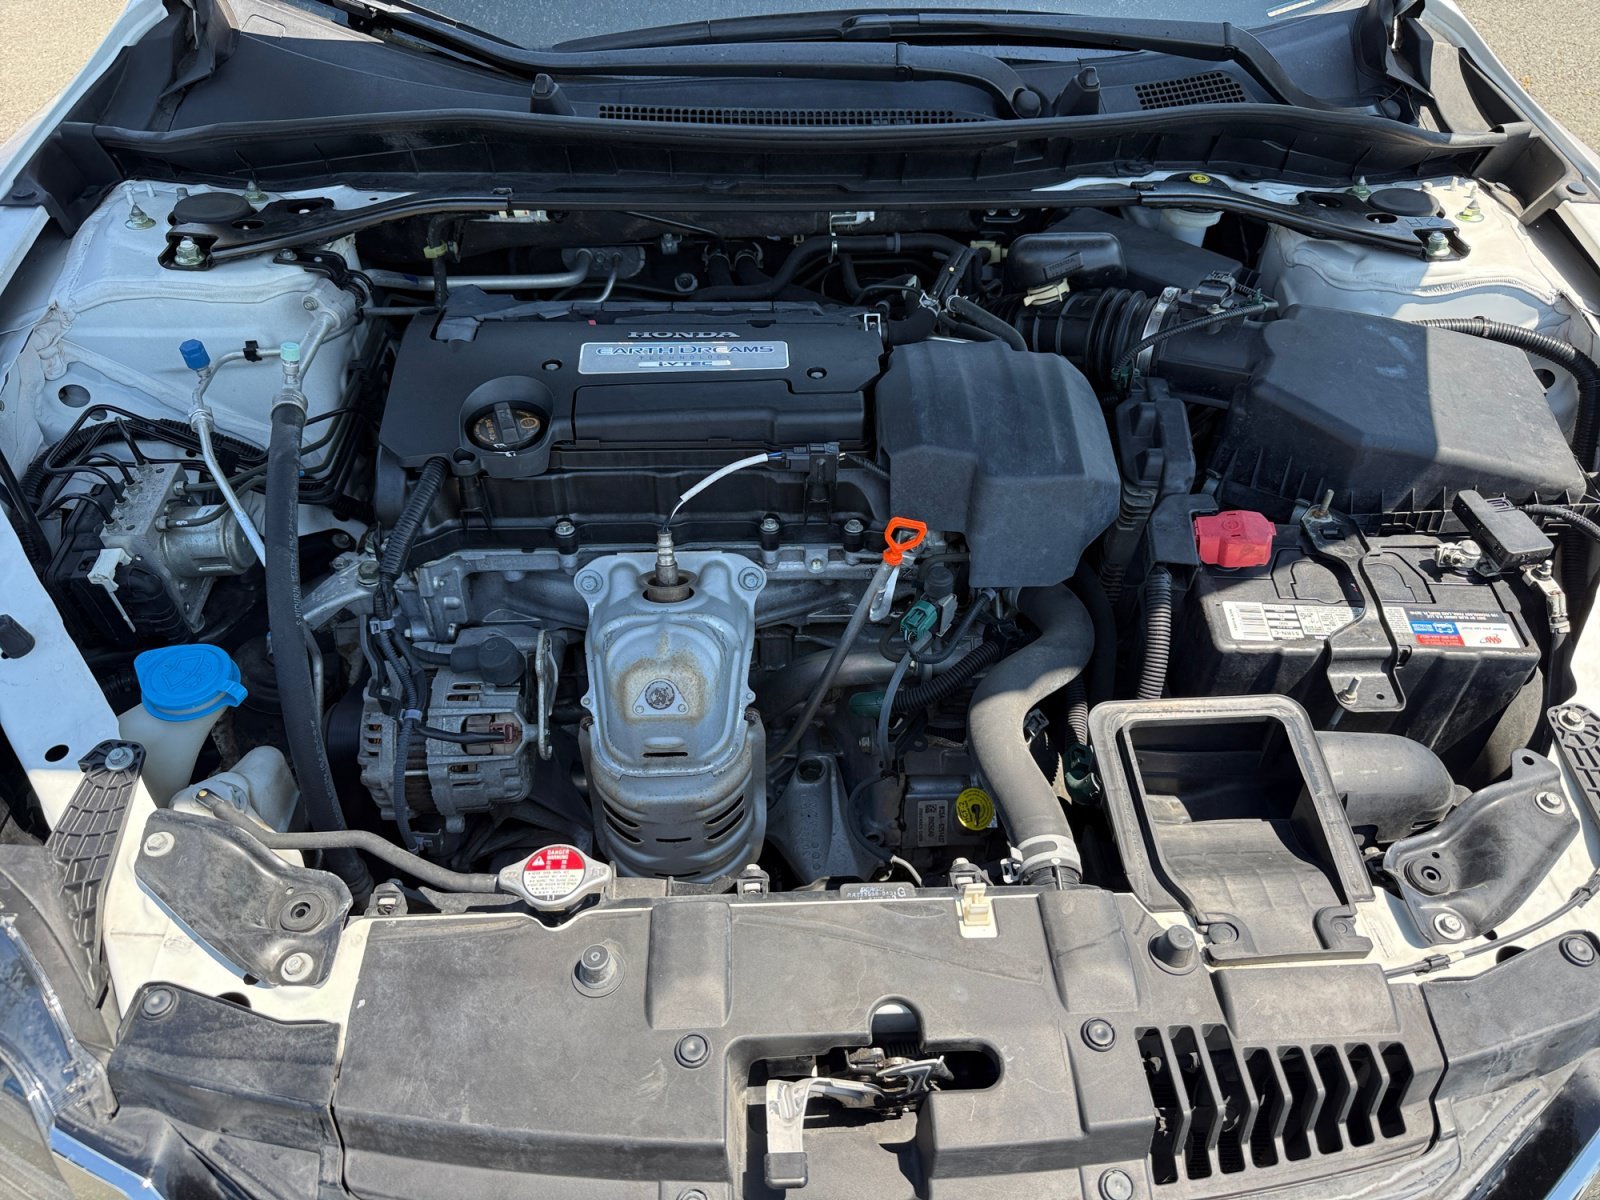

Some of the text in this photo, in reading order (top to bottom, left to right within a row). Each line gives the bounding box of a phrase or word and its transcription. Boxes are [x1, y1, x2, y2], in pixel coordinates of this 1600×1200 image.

[596, 345, 774, 356] EARTH DREAMS
[897, 886, 906, 897] G
